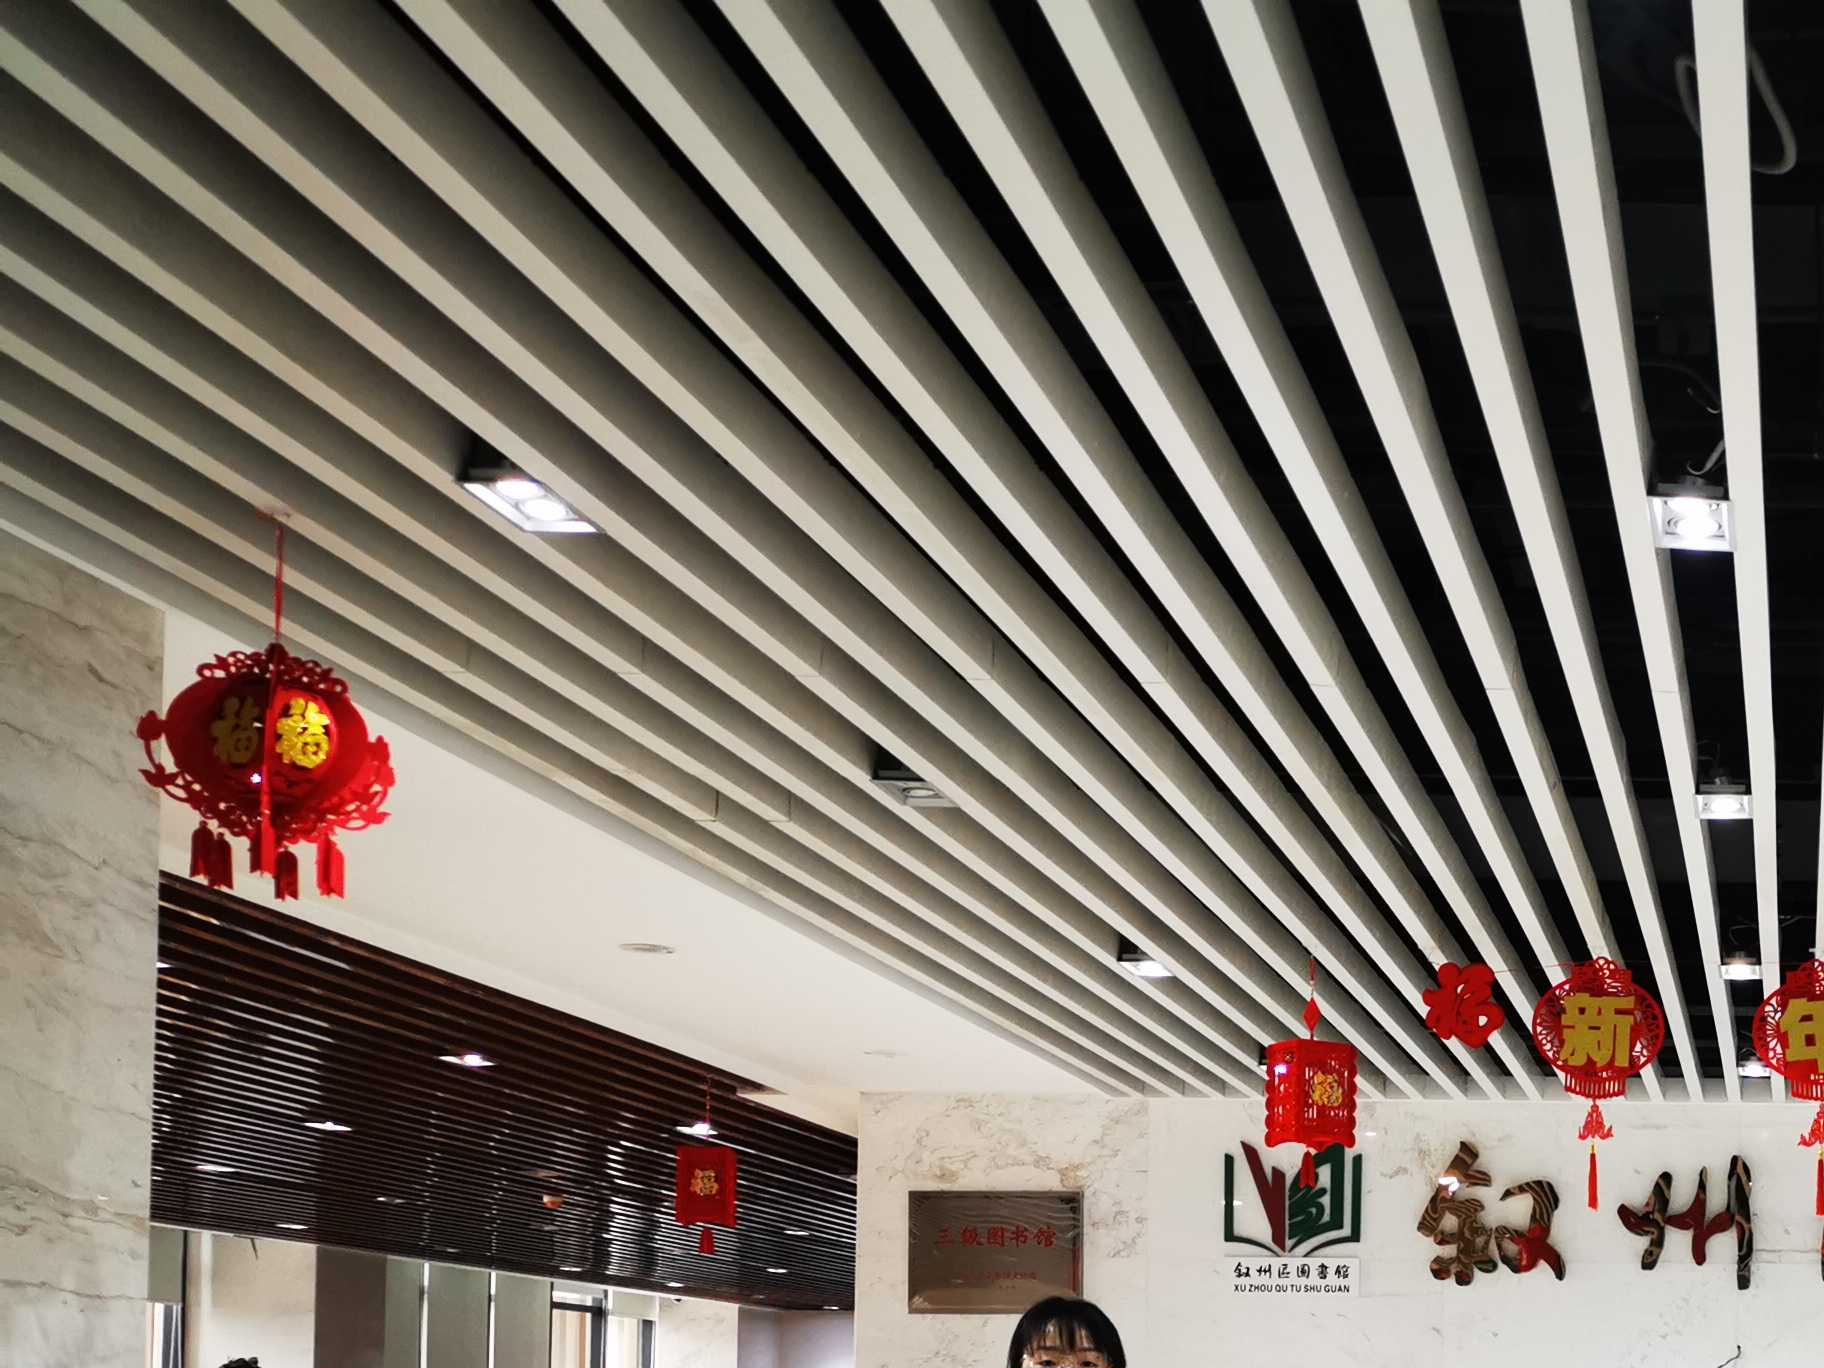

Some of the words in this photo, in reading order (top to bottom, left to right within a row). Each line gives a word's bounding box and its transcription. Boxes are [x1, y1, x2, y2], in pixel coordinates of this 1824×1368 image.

[1234, 1284, 1246, 1293] XU
[1248, 1284, 1272, 1293] ZHOU
[1275, 1284, 1288, 1293] QU
[1290, 1284, 1301, 1293] TU
[1304, 1284, 1322, 1293] SHU
[1323, 1284, 1350, 1293] GUAN
